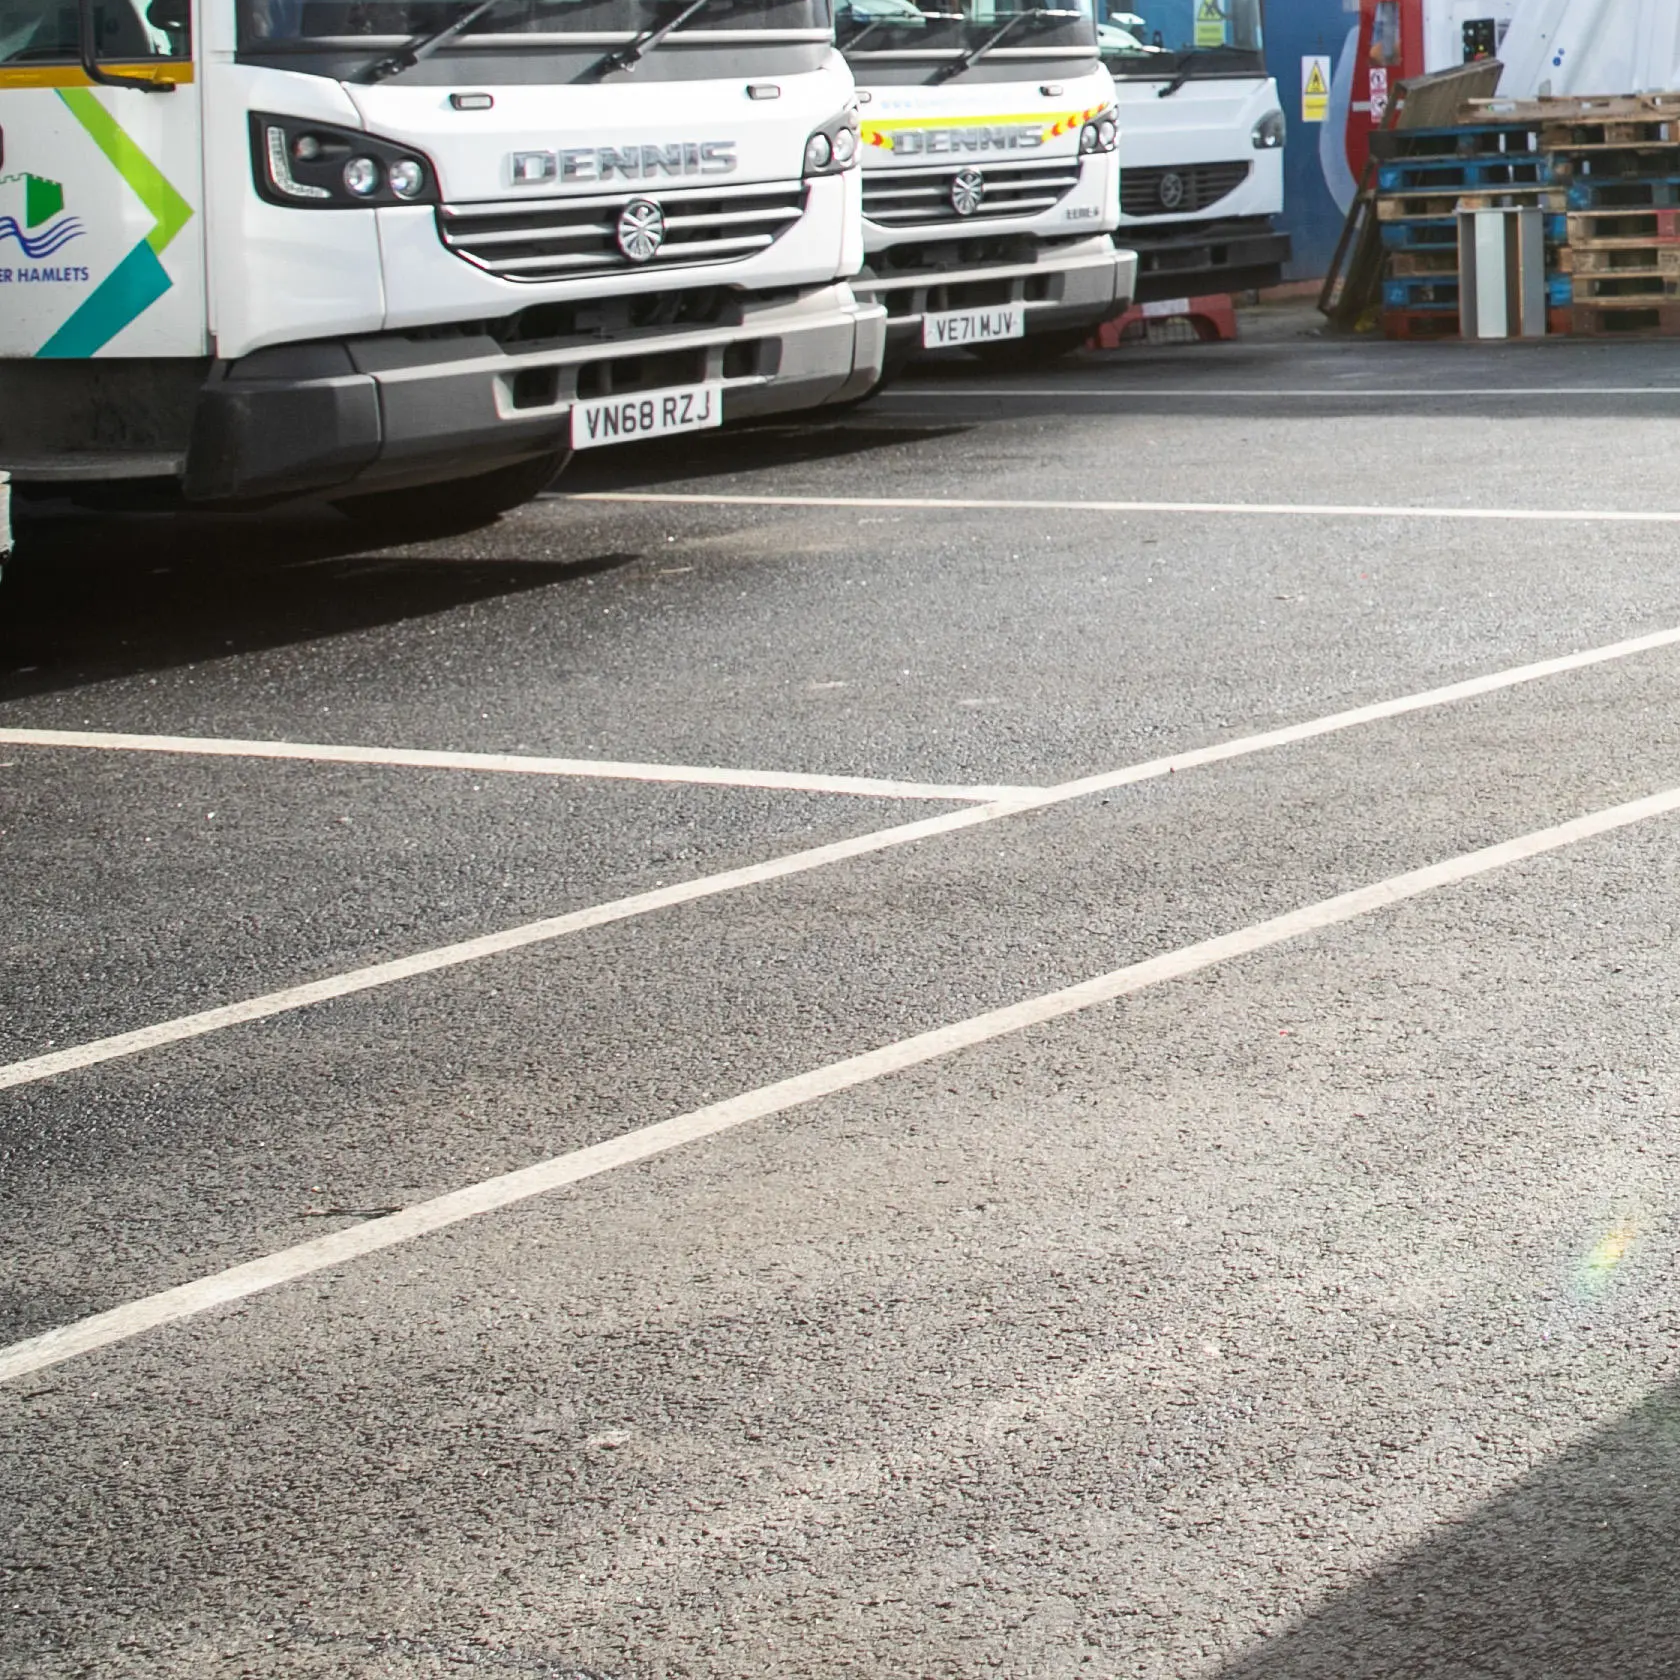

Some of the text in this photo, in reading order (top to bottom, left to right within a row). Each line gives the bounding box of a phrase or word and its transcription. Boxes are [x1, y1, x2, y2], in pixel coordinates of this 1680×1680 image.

[892, 124, 1043, 156] DENNIS
[511, 140, 738, 186] DENNIS
[18, 266, 89, 281] HAMLETS
[937, 312, 1012, 342] VE71 MJV
[586, 390, 710, 439] VN68 RZJ
